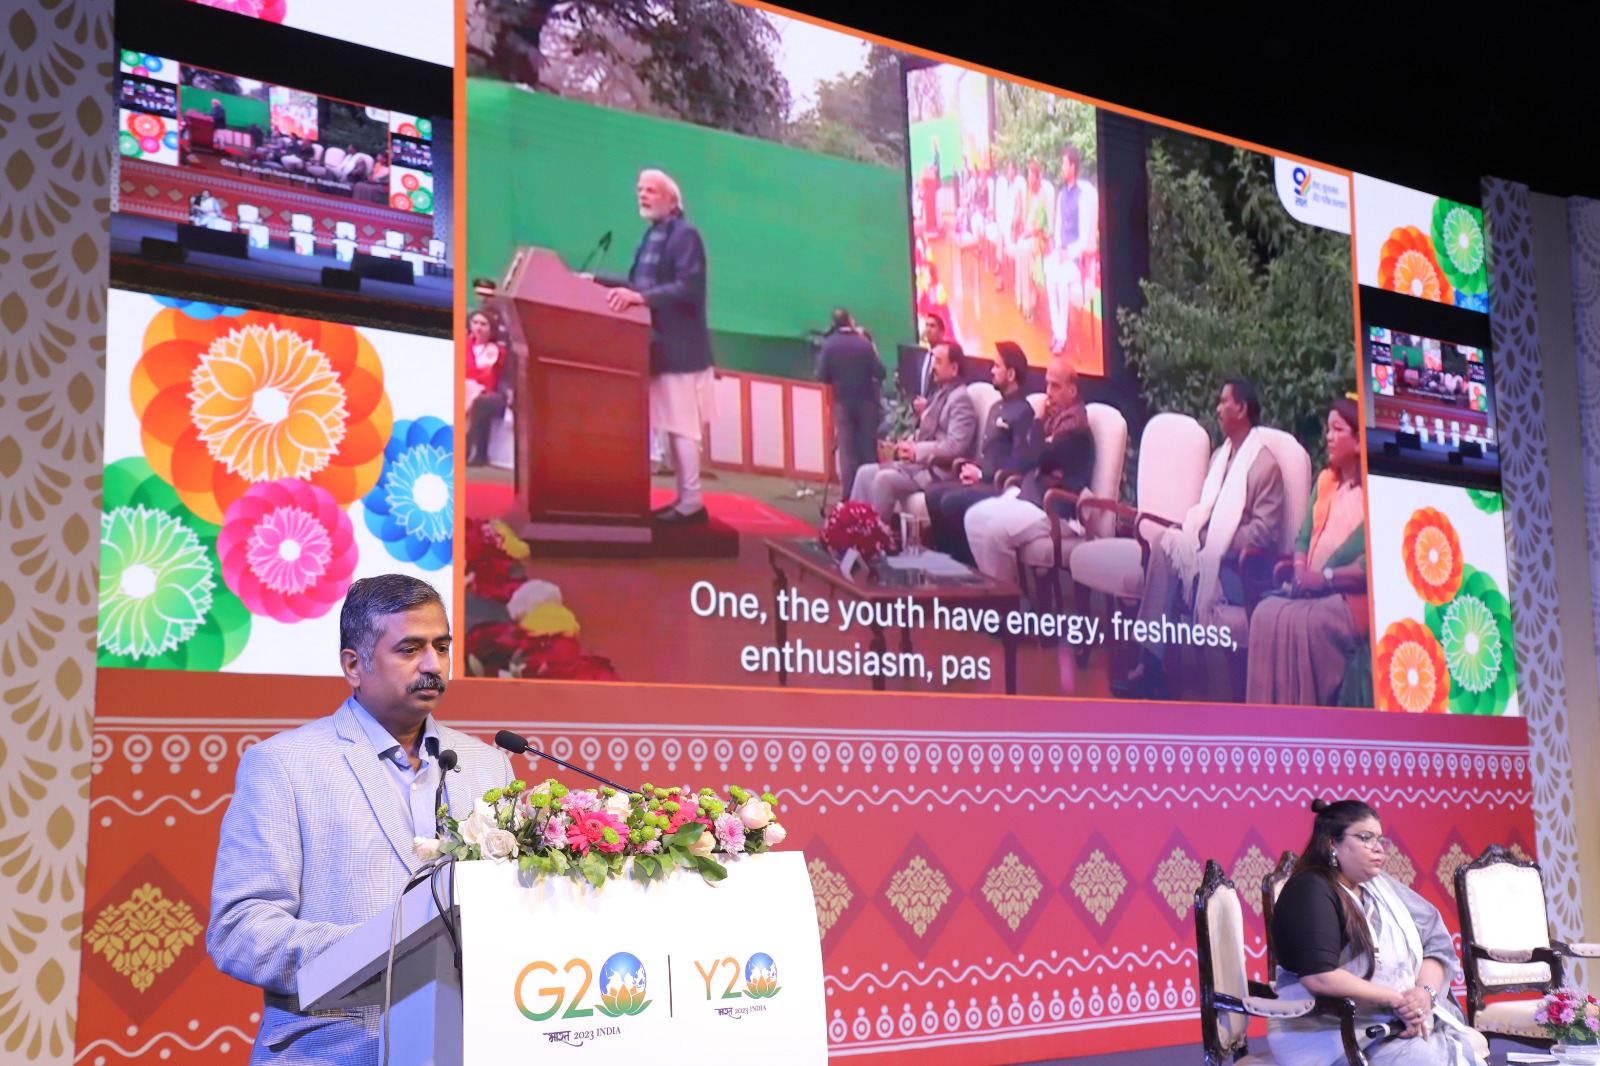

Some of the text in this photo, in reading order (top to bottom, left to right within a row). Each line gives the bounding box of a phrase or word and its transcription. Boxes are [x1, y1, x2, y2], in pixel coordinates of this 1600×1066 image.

[690, 581, 1238, 651] One, the youth have energy, freshness,
[741, 640, 991, 685] enthusiasm, pas
[734, 1007, 749, 1015] 2023
[749, 1005, 767, 1013] INDIA
[573, 1030, 595, 1040] 2023
[596, 1026, 621, 1037] INDIA
